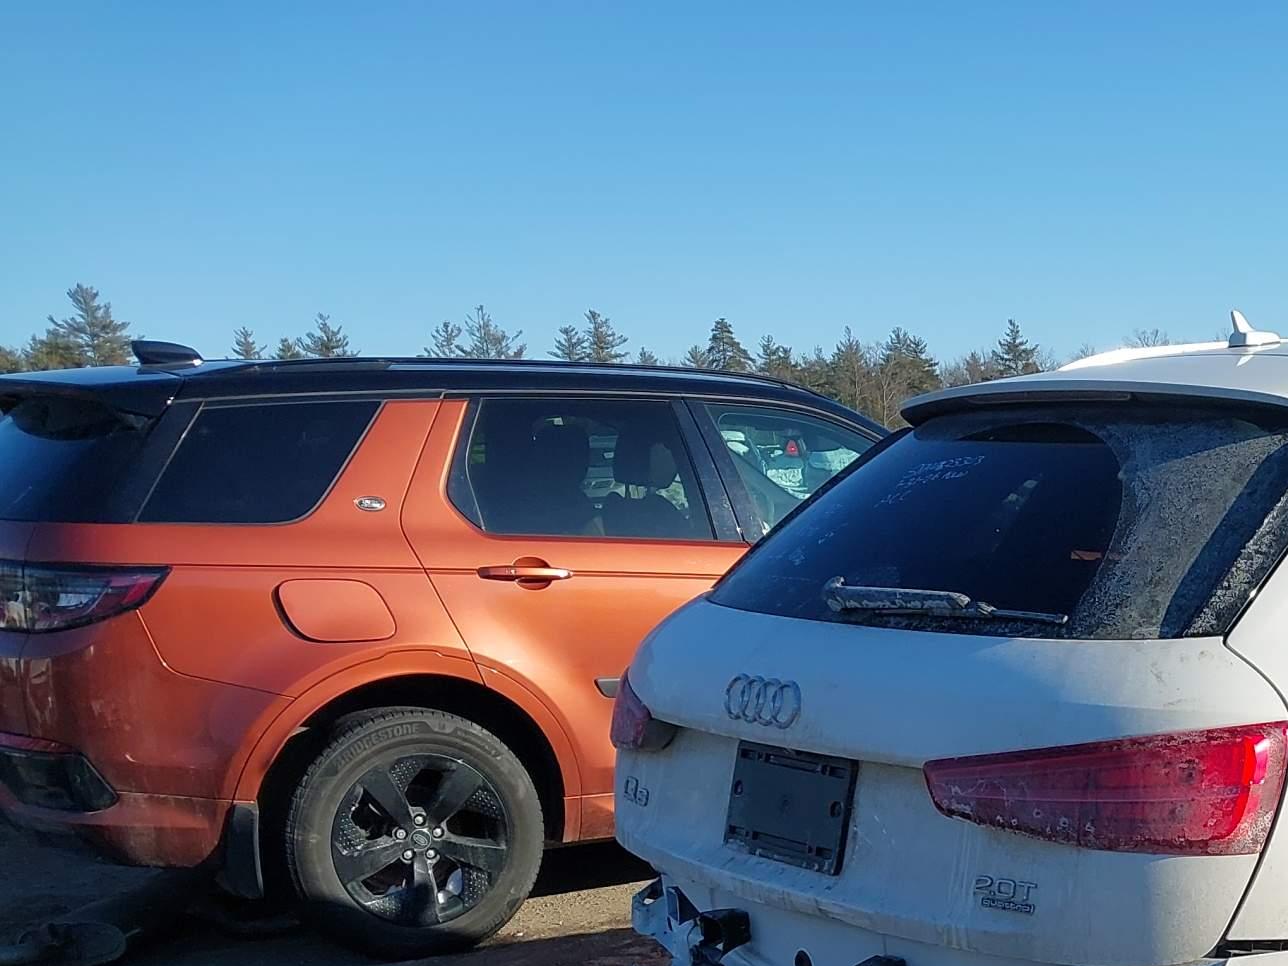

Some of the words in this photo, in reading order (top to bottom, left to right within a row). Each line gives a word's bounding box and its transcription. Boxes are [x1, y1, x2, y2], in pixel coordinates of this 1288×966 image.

[335, 722, 421, 768] BRIDGESTONE
[623, 775, 650, 807] Q3
[973, 874, 1038, 902] 2.0T
